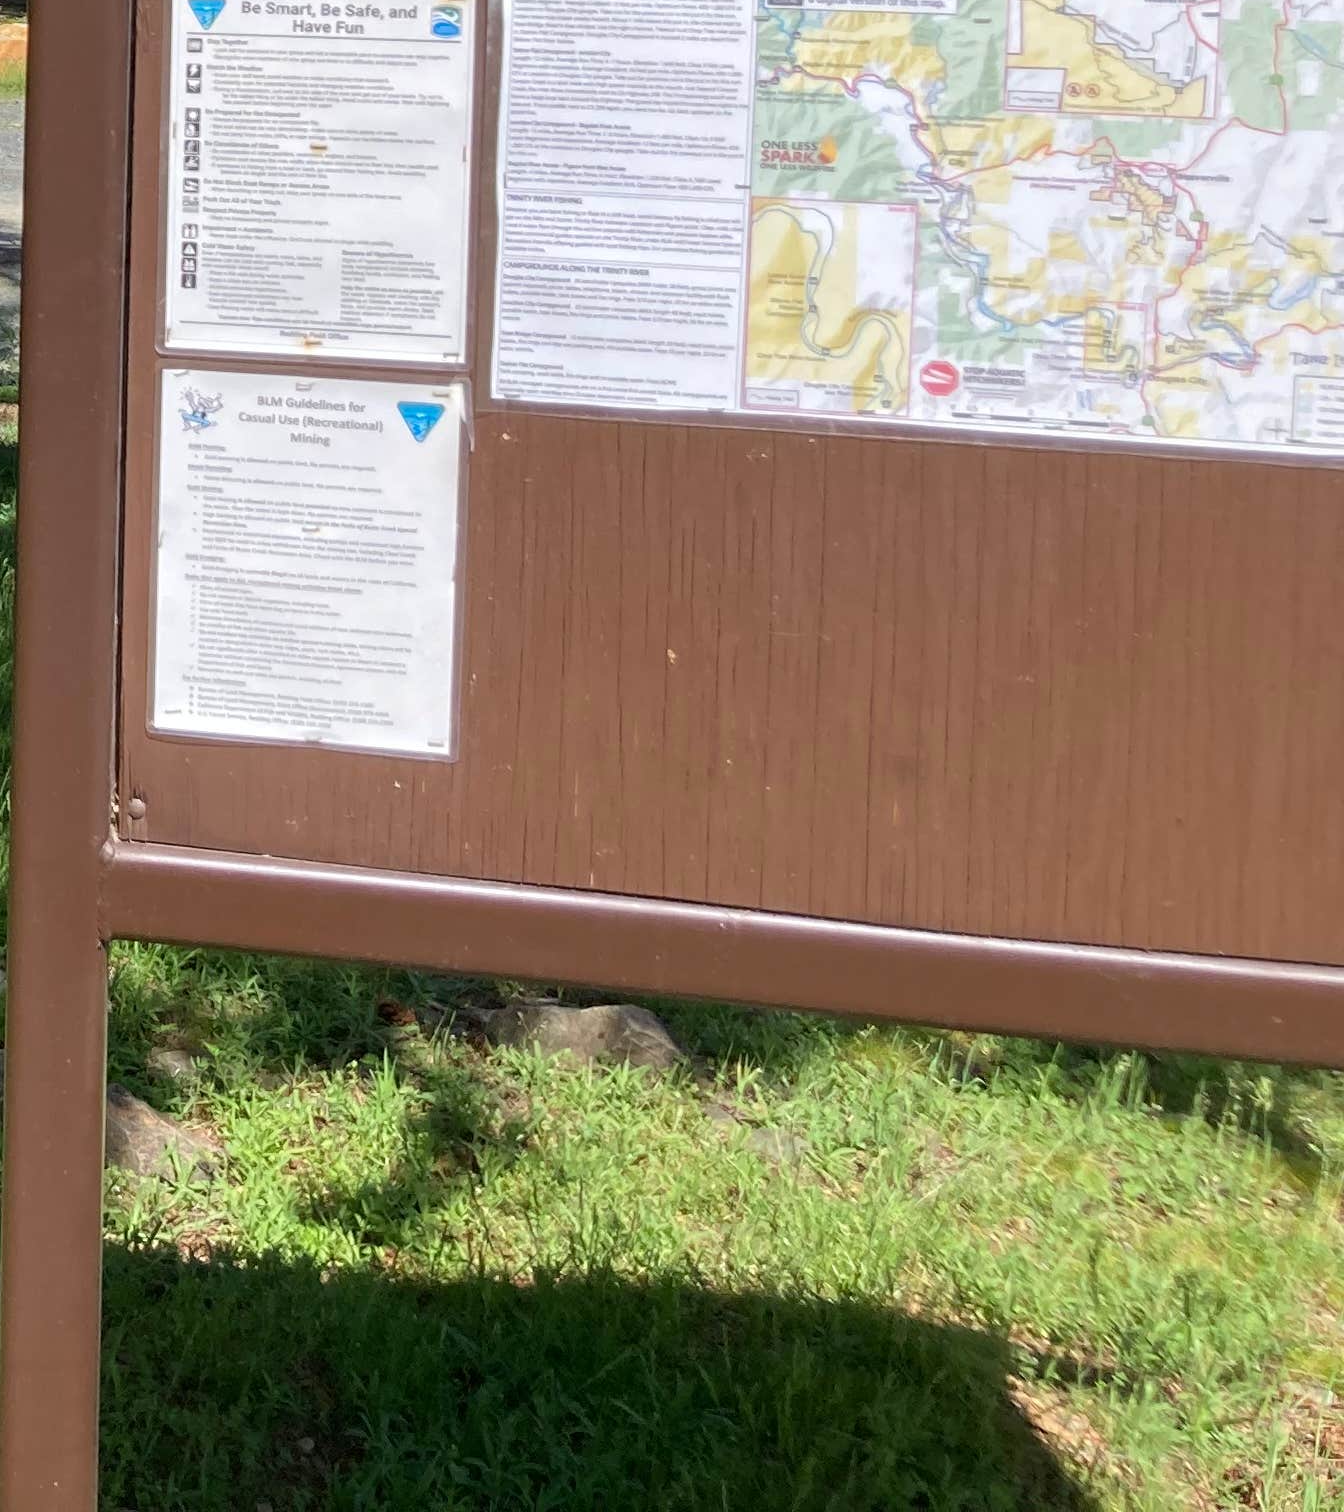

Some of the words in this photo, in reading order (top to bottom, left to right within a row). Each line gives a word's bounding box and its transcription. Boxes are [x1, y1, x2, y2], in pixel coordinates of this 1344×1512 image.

[240, 1, 261, 14] Be
[265, 2, 316, 17] Smart,
[320, 3, 341, 16] Be
[345, 4, 384, 19] Safe,
[387, 6, 418, 19] and
[292, 20, 332, 34] Have
[335, 21, 364, 34] Fun
[761, 140, 788, 149] ONE
[792, 141, 817, 151] LESS
[257, 395, 283, 407] BLM
[286, 397, 346, 412] Guidelines
[348, 400, 366, 413] for
[238, 412, 276, 425] Casual
[279, 414, 300, 426] Use
[302, 415, 384, 433] (Recreational)
[290, 432, 331, 447] Mining
